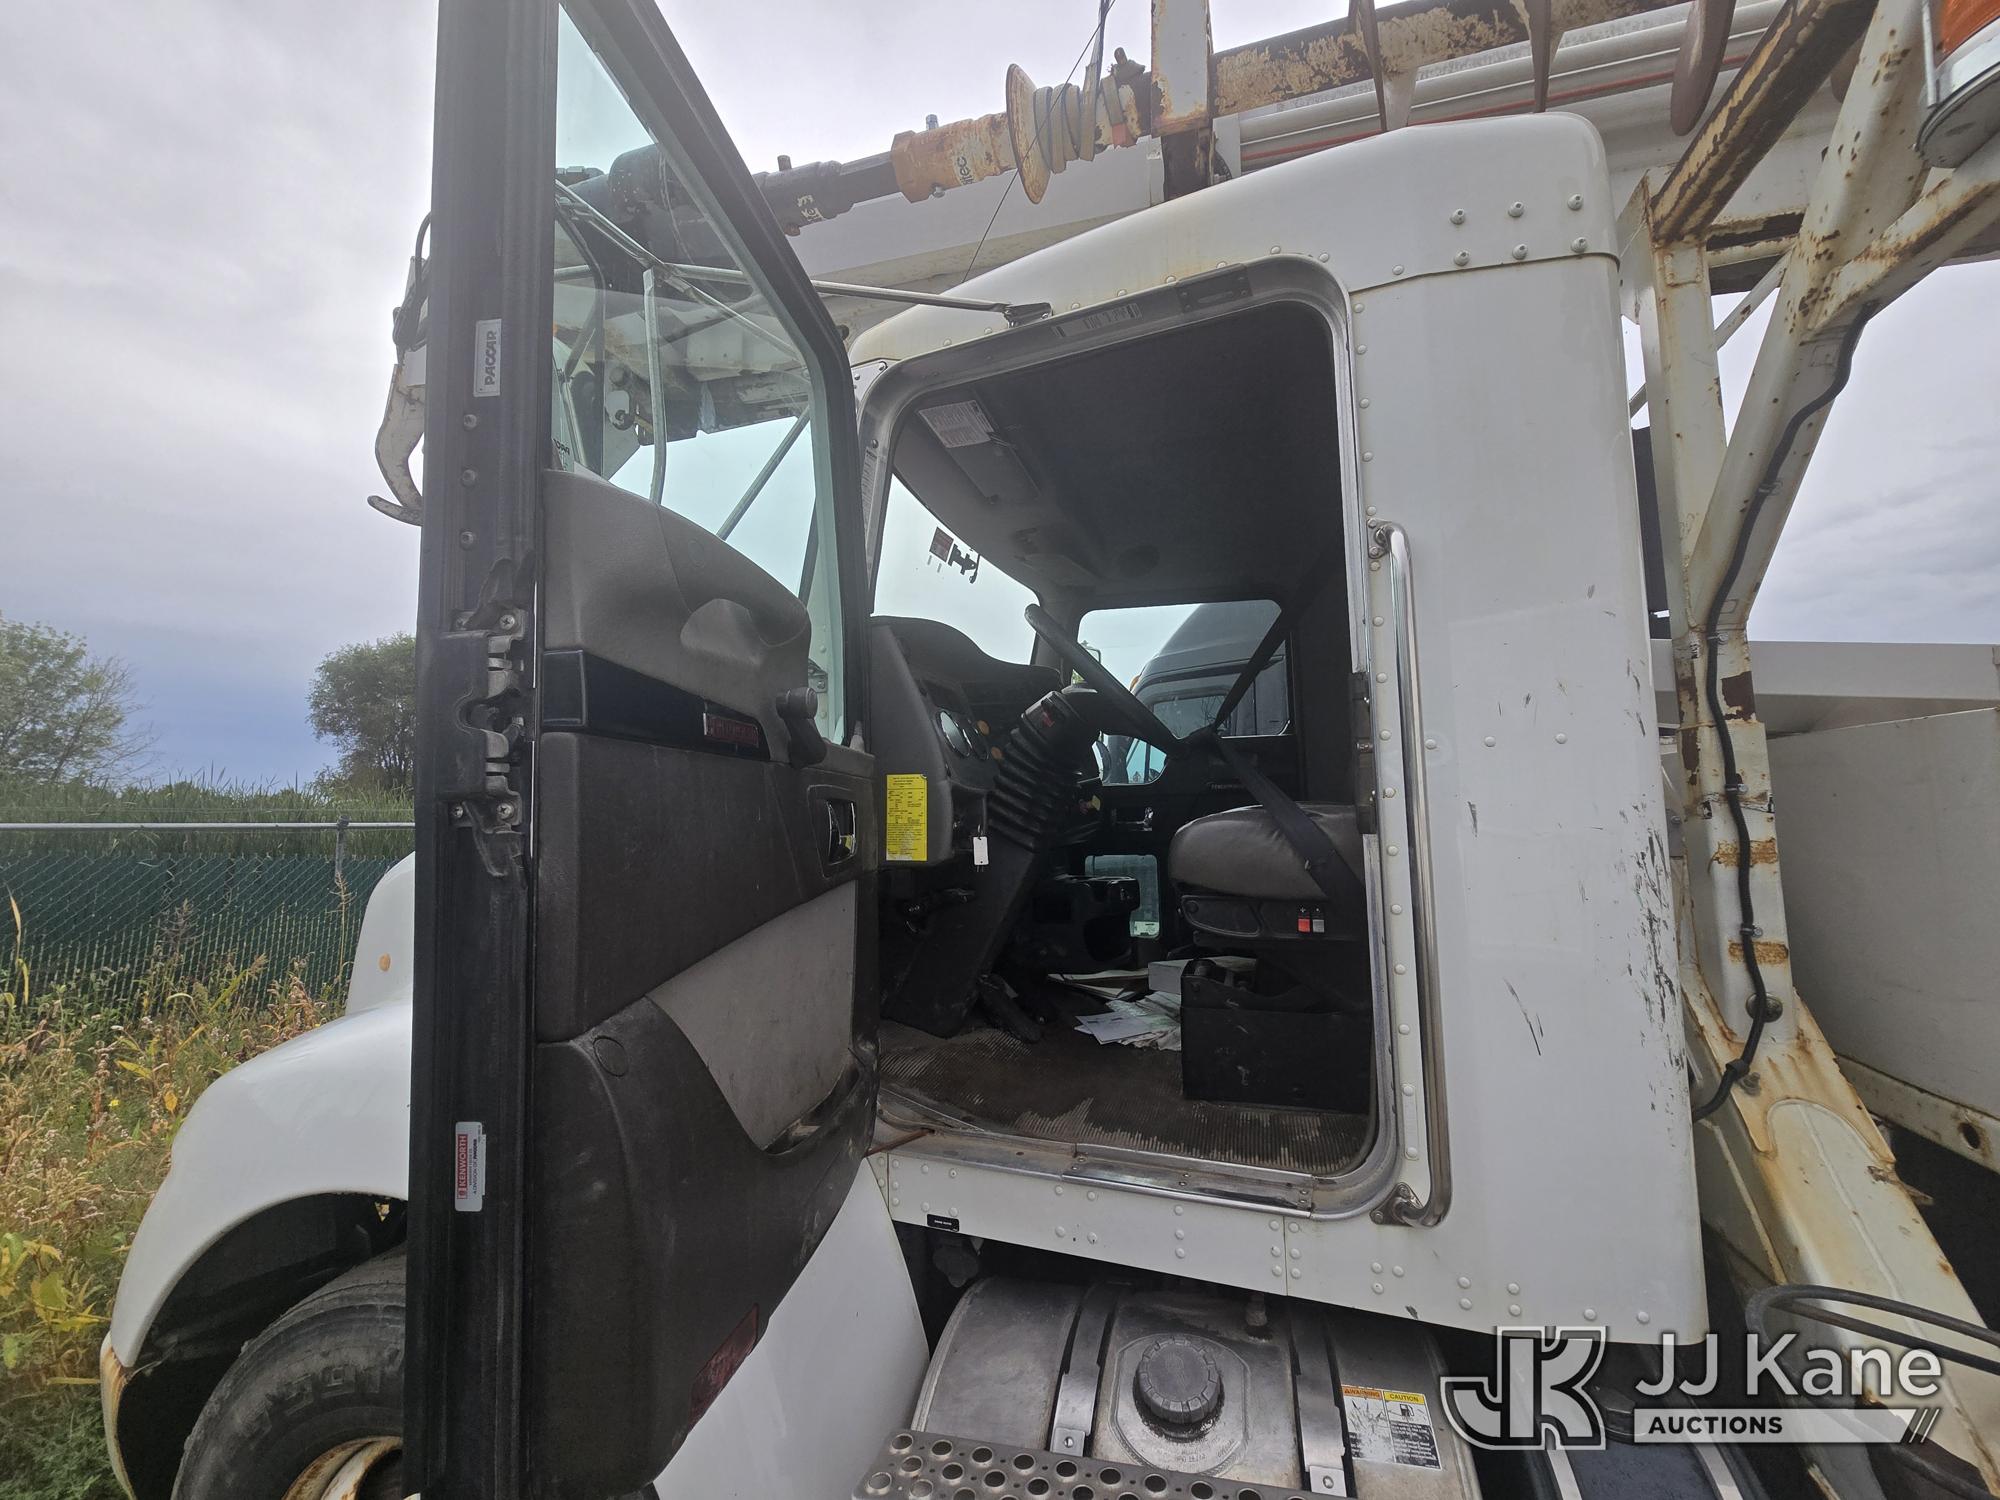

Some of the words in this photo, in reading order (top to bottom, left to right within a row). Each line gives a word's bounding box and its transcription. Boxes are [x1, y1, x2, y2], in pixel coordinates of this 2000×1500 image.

[484, 330, 497, 386] PACCAR
[458, 1135, 467, 1187] KENWORTH
[1389, 1393, 1419, 1402] CAUTION
